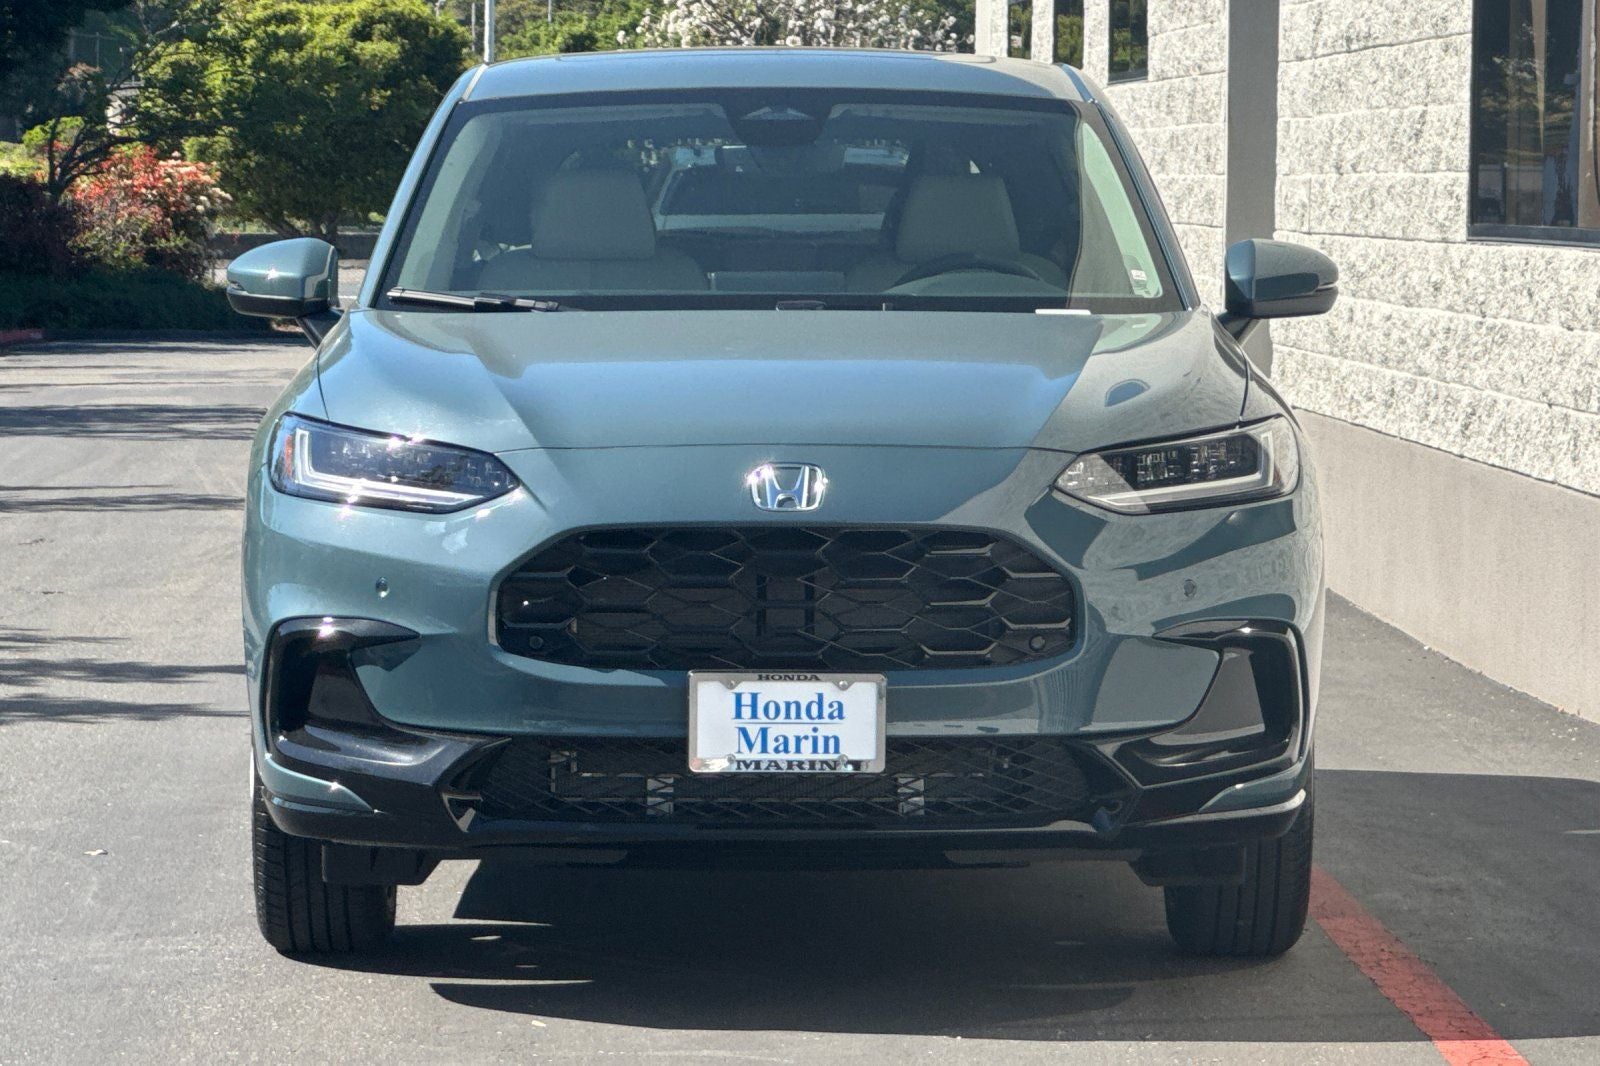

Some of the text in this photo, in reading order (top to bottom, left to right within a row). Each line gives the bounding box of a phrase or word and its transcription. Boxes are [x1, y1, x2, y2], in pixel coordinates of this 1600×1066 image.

[731, 692, 846, 720] Honda
[735, 726, 841, 755] Marin
[735, 760, 838, 771] MARIN
